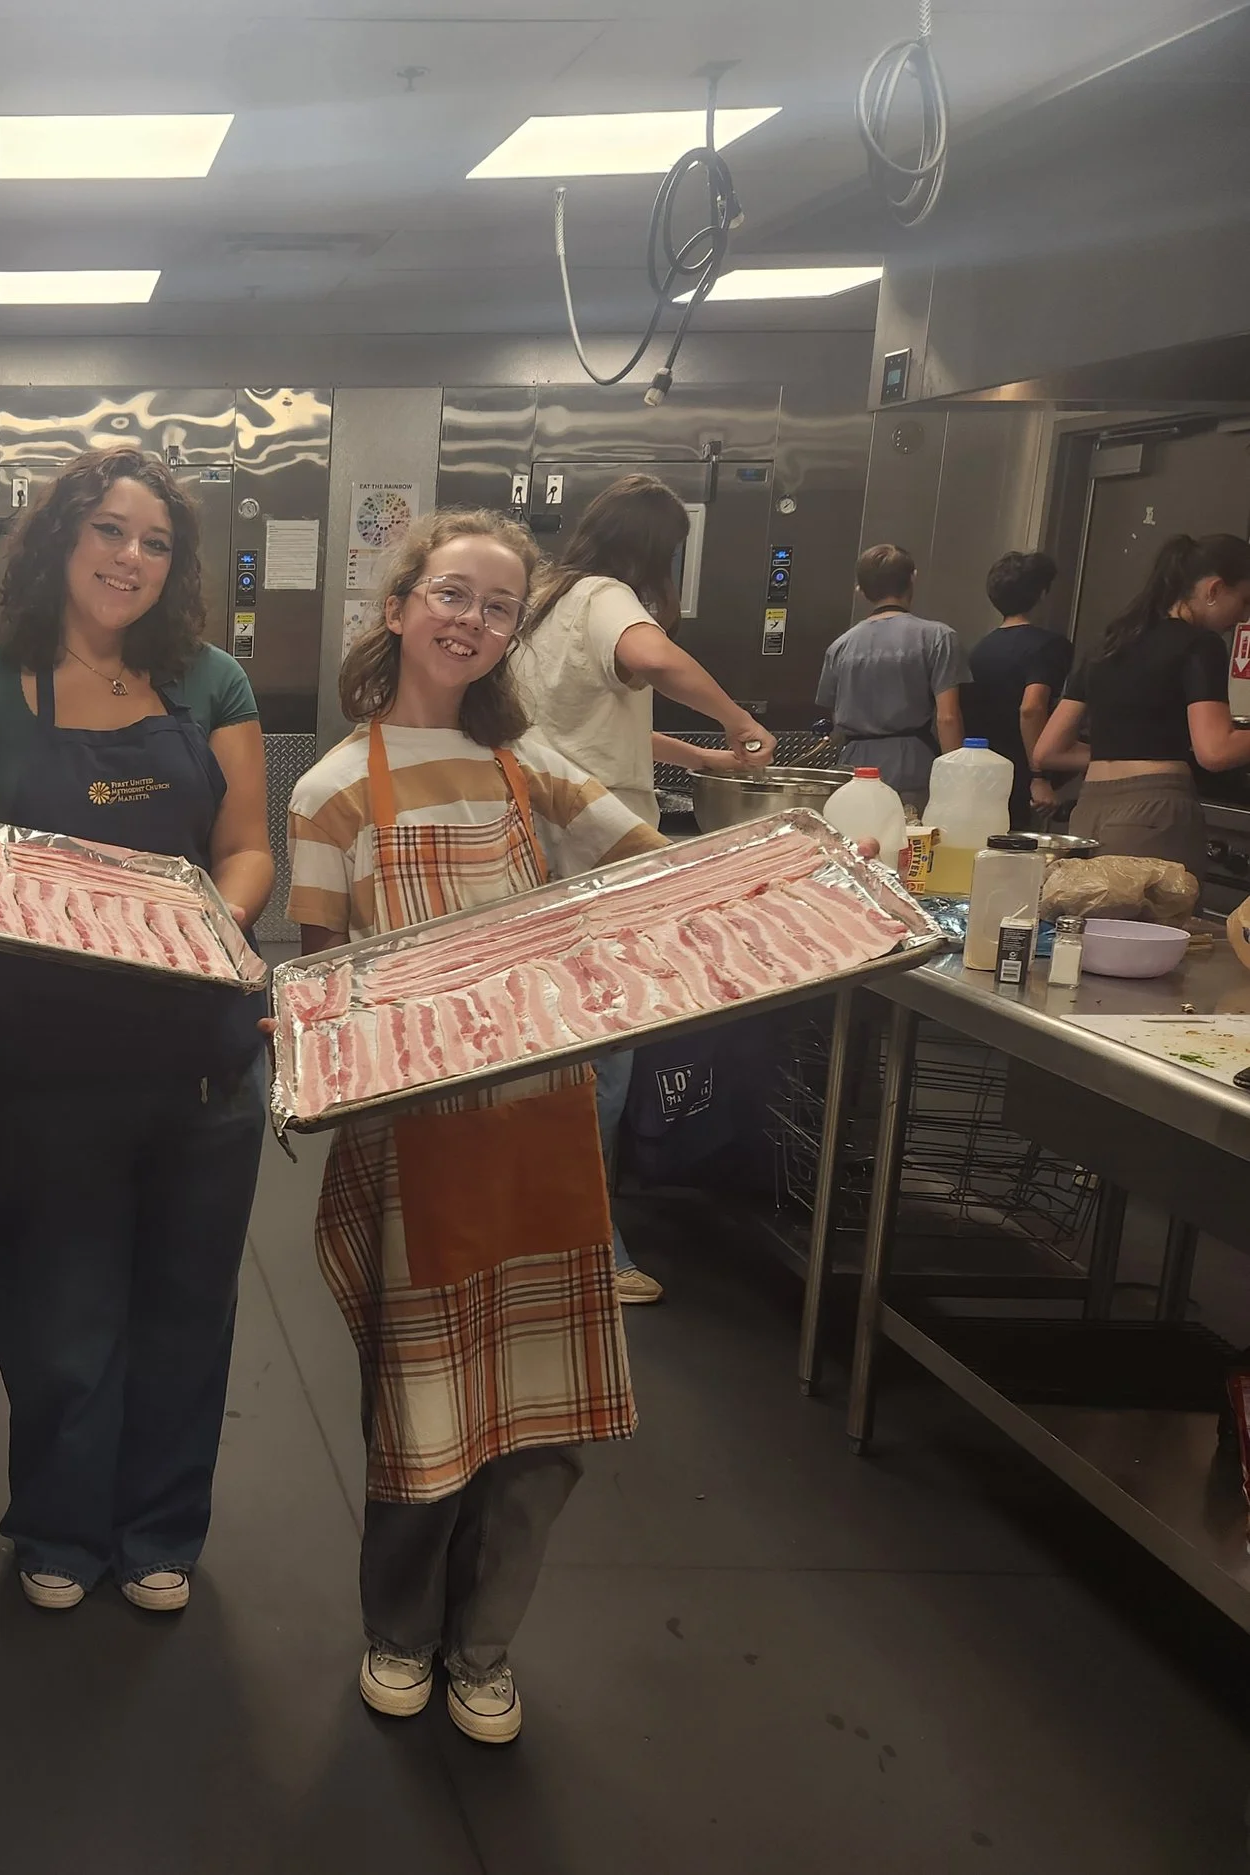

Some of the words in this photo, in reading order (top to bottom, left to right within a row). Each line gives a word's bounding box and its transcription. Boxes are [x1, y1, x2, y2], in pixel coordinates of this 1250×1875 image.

[130, 778, 153, 786] UNITED
[111, 786, 145, 795] METHODIST
[118, 794, 150, 802] MARIETTA
